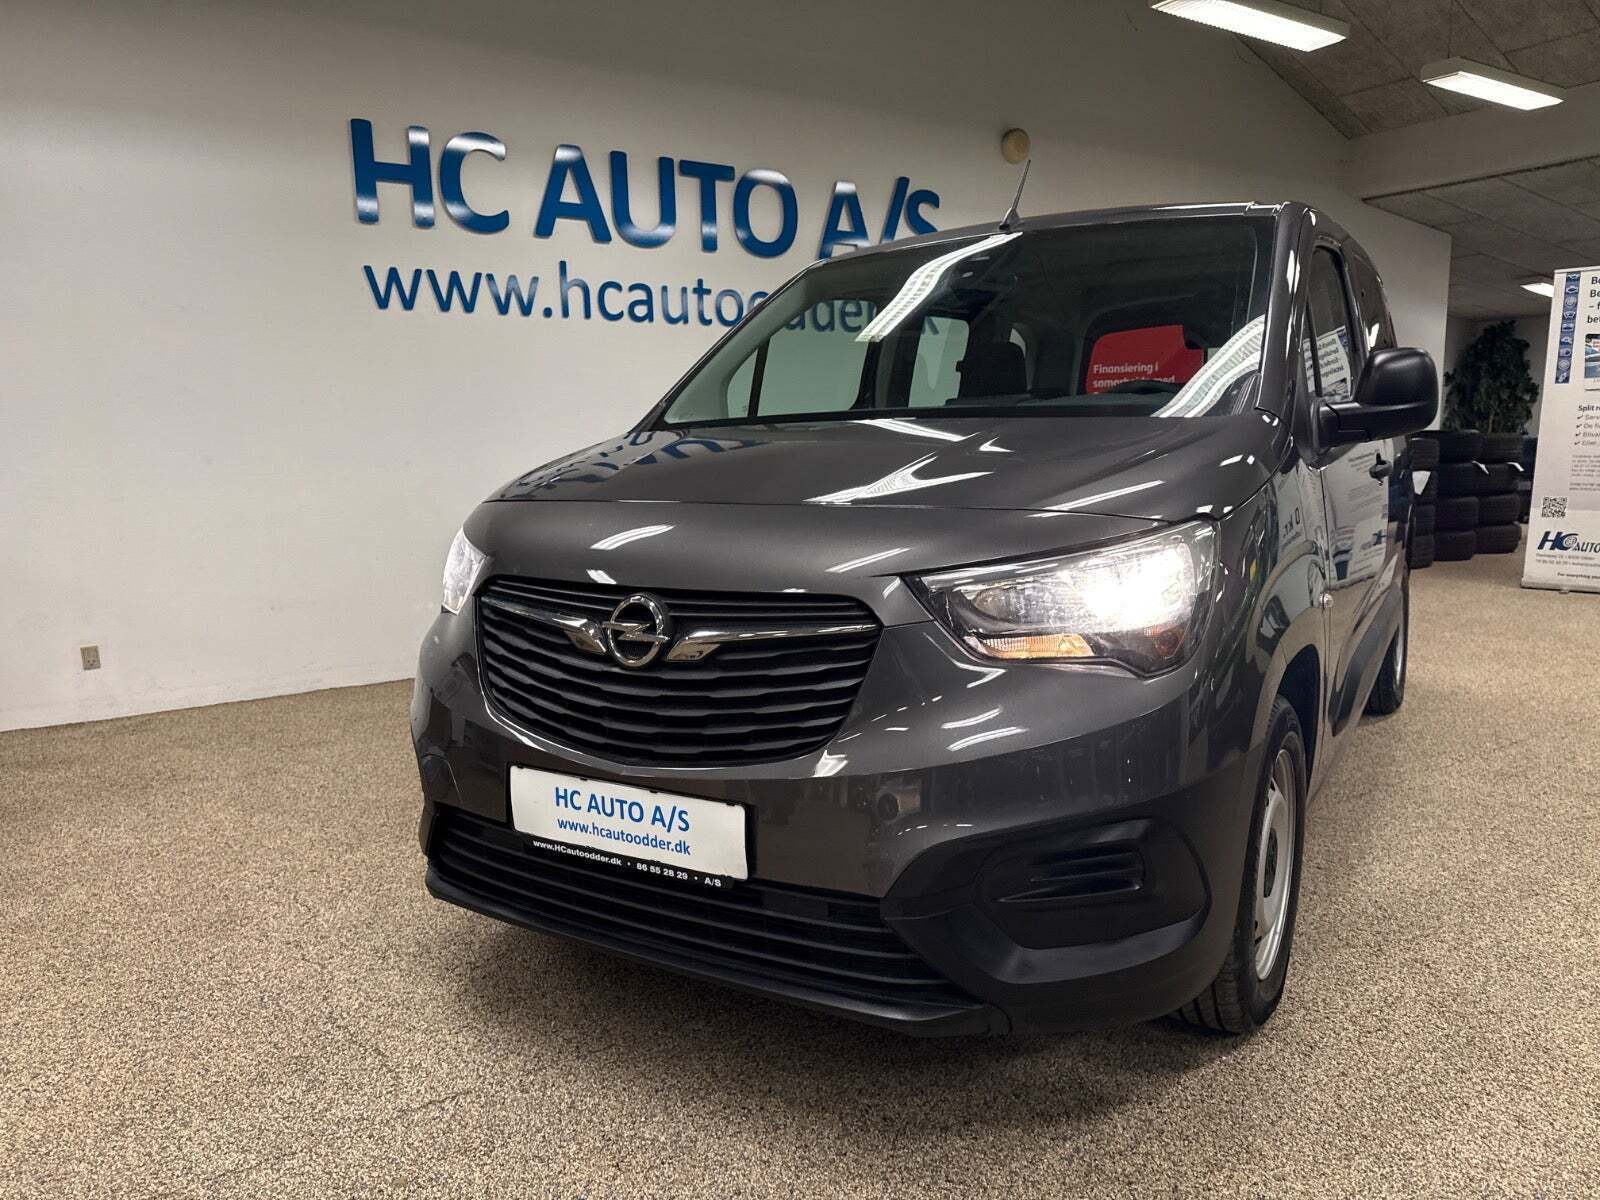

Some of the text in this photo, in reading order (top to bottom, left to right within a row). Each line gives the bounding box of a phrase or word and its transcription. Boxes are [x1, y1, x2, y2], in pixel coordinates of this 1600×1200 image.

[350, 118, 940, 260] HC AUTO A/S
[1093, 363, 1153, 375] Finansiering
[1537, 530, 1579, 551] HC
[555, 786, 691, 833] HC AUTO A/S
[557, 817, 691, 856] www.hcautoodder.dk
[533, 840, 722, 887] www.HCautoodder.dk 86 55 28 29 A/S
